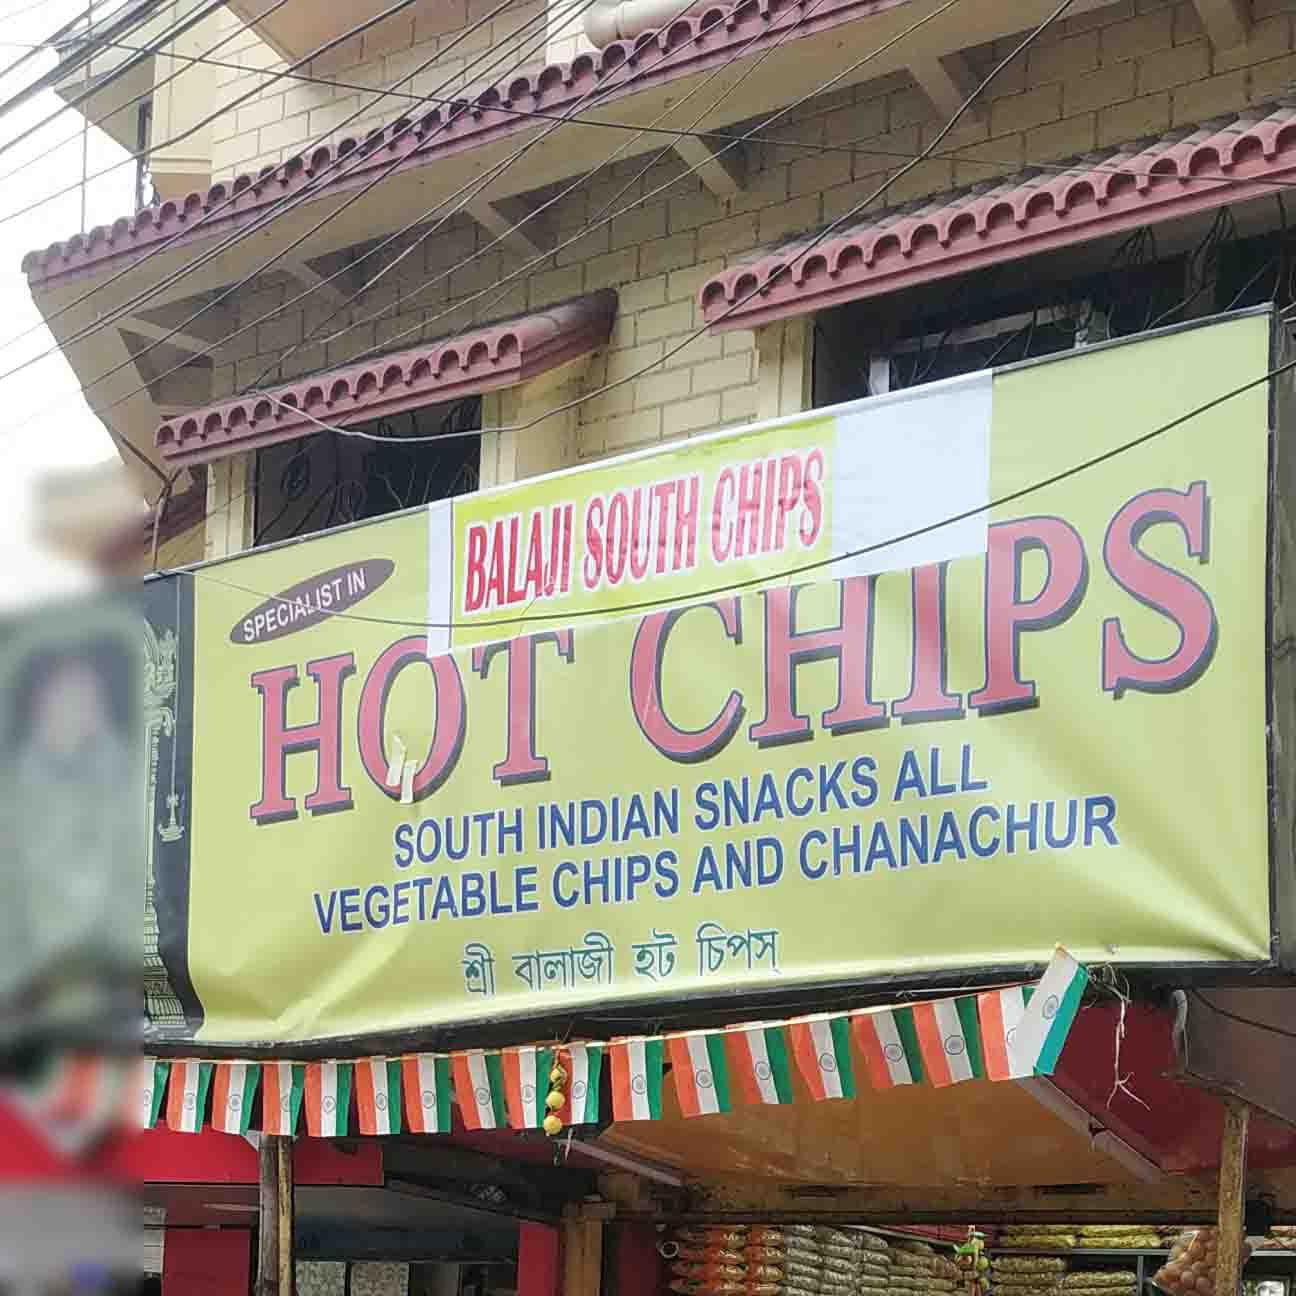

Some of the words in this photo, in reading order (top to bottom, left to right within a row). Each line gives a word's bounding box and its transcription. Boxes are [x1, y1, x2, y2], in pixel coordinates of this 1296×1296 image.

[464, 502, 572, 613] BALAJI
[583, 476, 699, 590] SOUTH
[711, 447, 824, 562] CHIPS
[243, 578, 343, 642] SPECIALIST
[347, 567, 367, 596] IN
[250, 632, 574, 825] HOT
[630, 481, 1219, 764] CHIPS
[313, 866, 540, 934] VEGETABLE
[552, 851, 680, 908] CHIPS
[692, 837, 784, 894] AND
[799, 795, 1119, 880] CHANACHUR
[394, 809, 523, 868] SOUTH
[537, 788, 680, 850] INDIAN
[694, 756, 879, 831] SNACKS
[894, 744, 988, 801] ALL
[462, 943, 496, 997] শ্রী
[512, 931, 615, 992] বালাজী
[632, 928, 678, 983] হট
